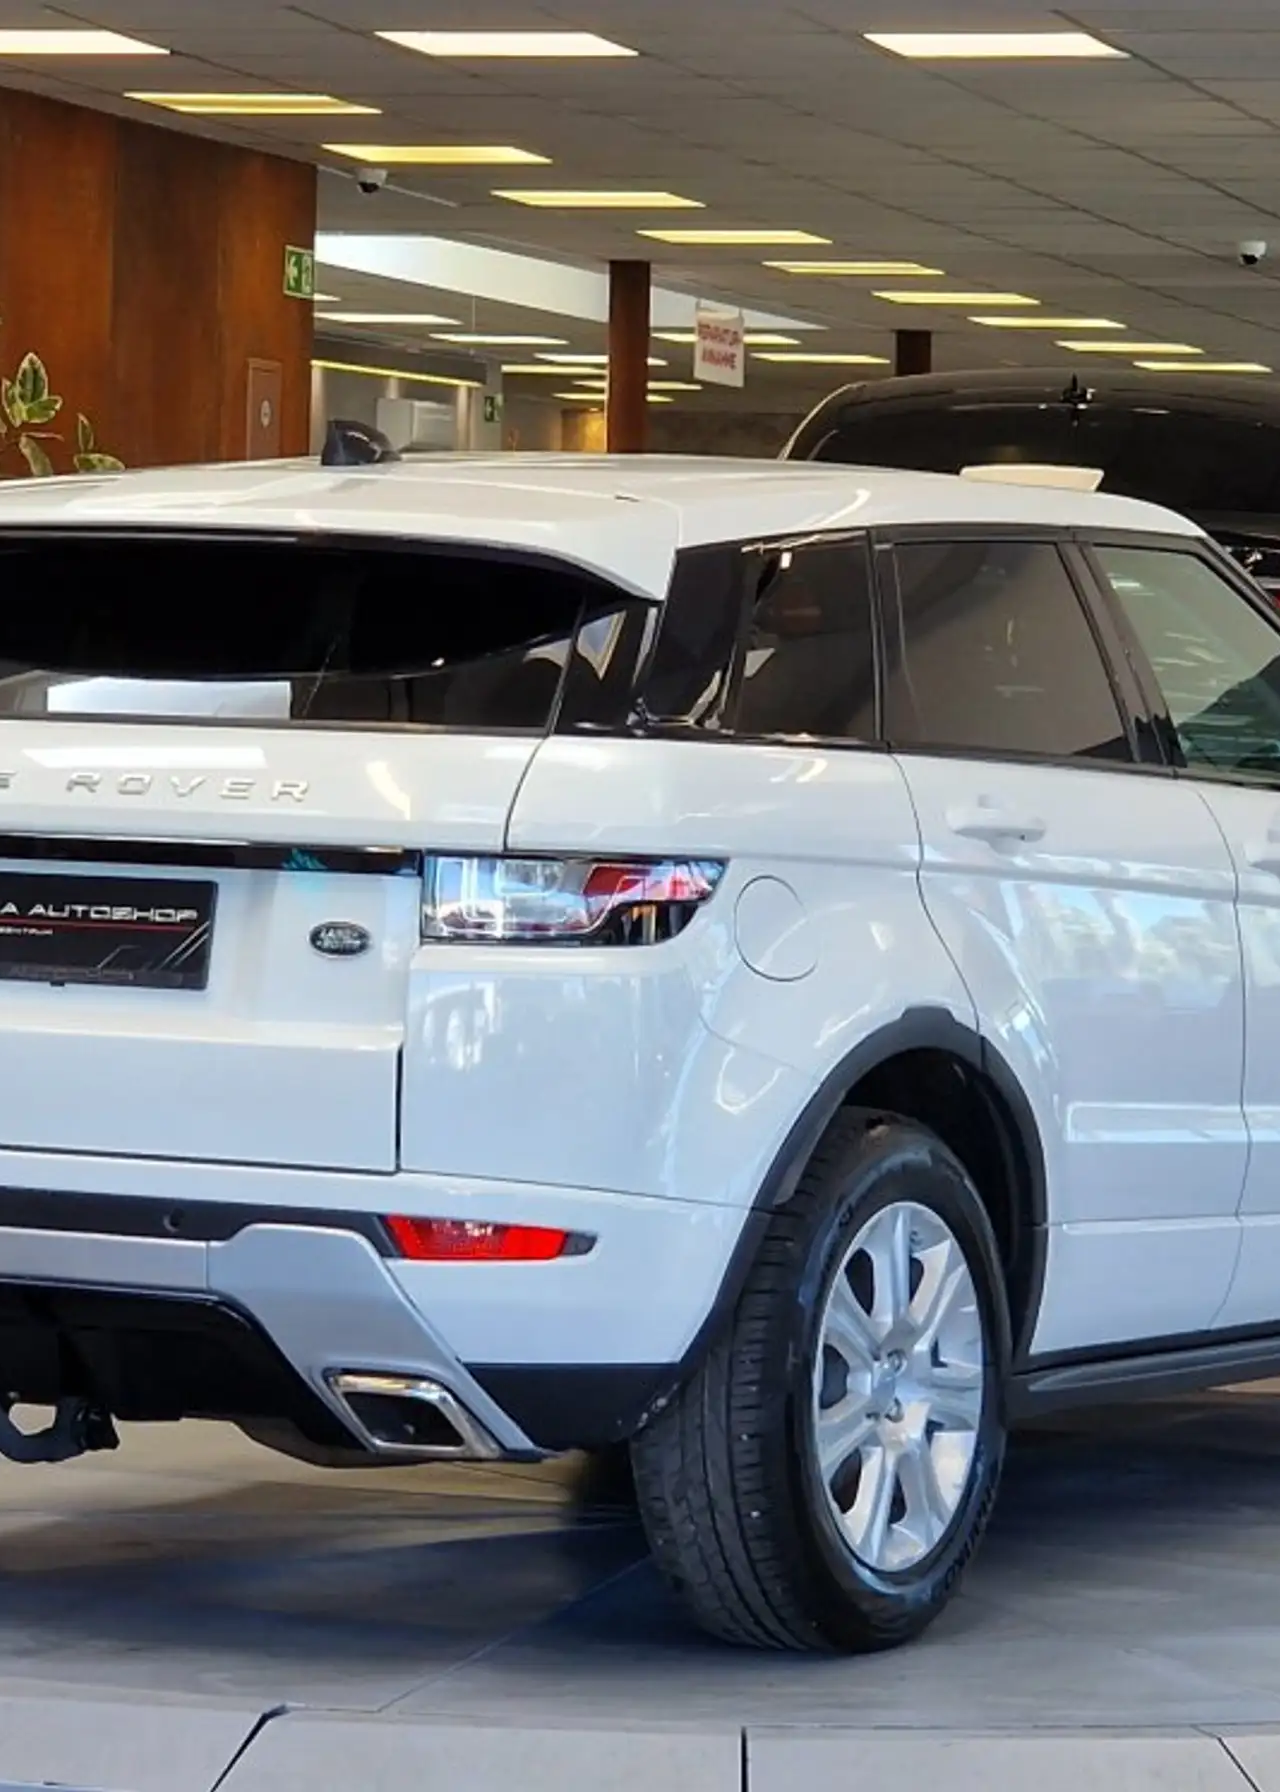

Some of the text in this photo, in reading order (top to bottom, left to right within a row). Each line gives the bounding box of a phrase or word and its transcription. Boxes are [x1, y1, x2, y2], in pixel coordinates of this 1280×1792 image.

[65, 771, 311, 803] ROVER
[0, 901, 20, 915] A
[28, 903, 200, 923] AUTOSHOP
